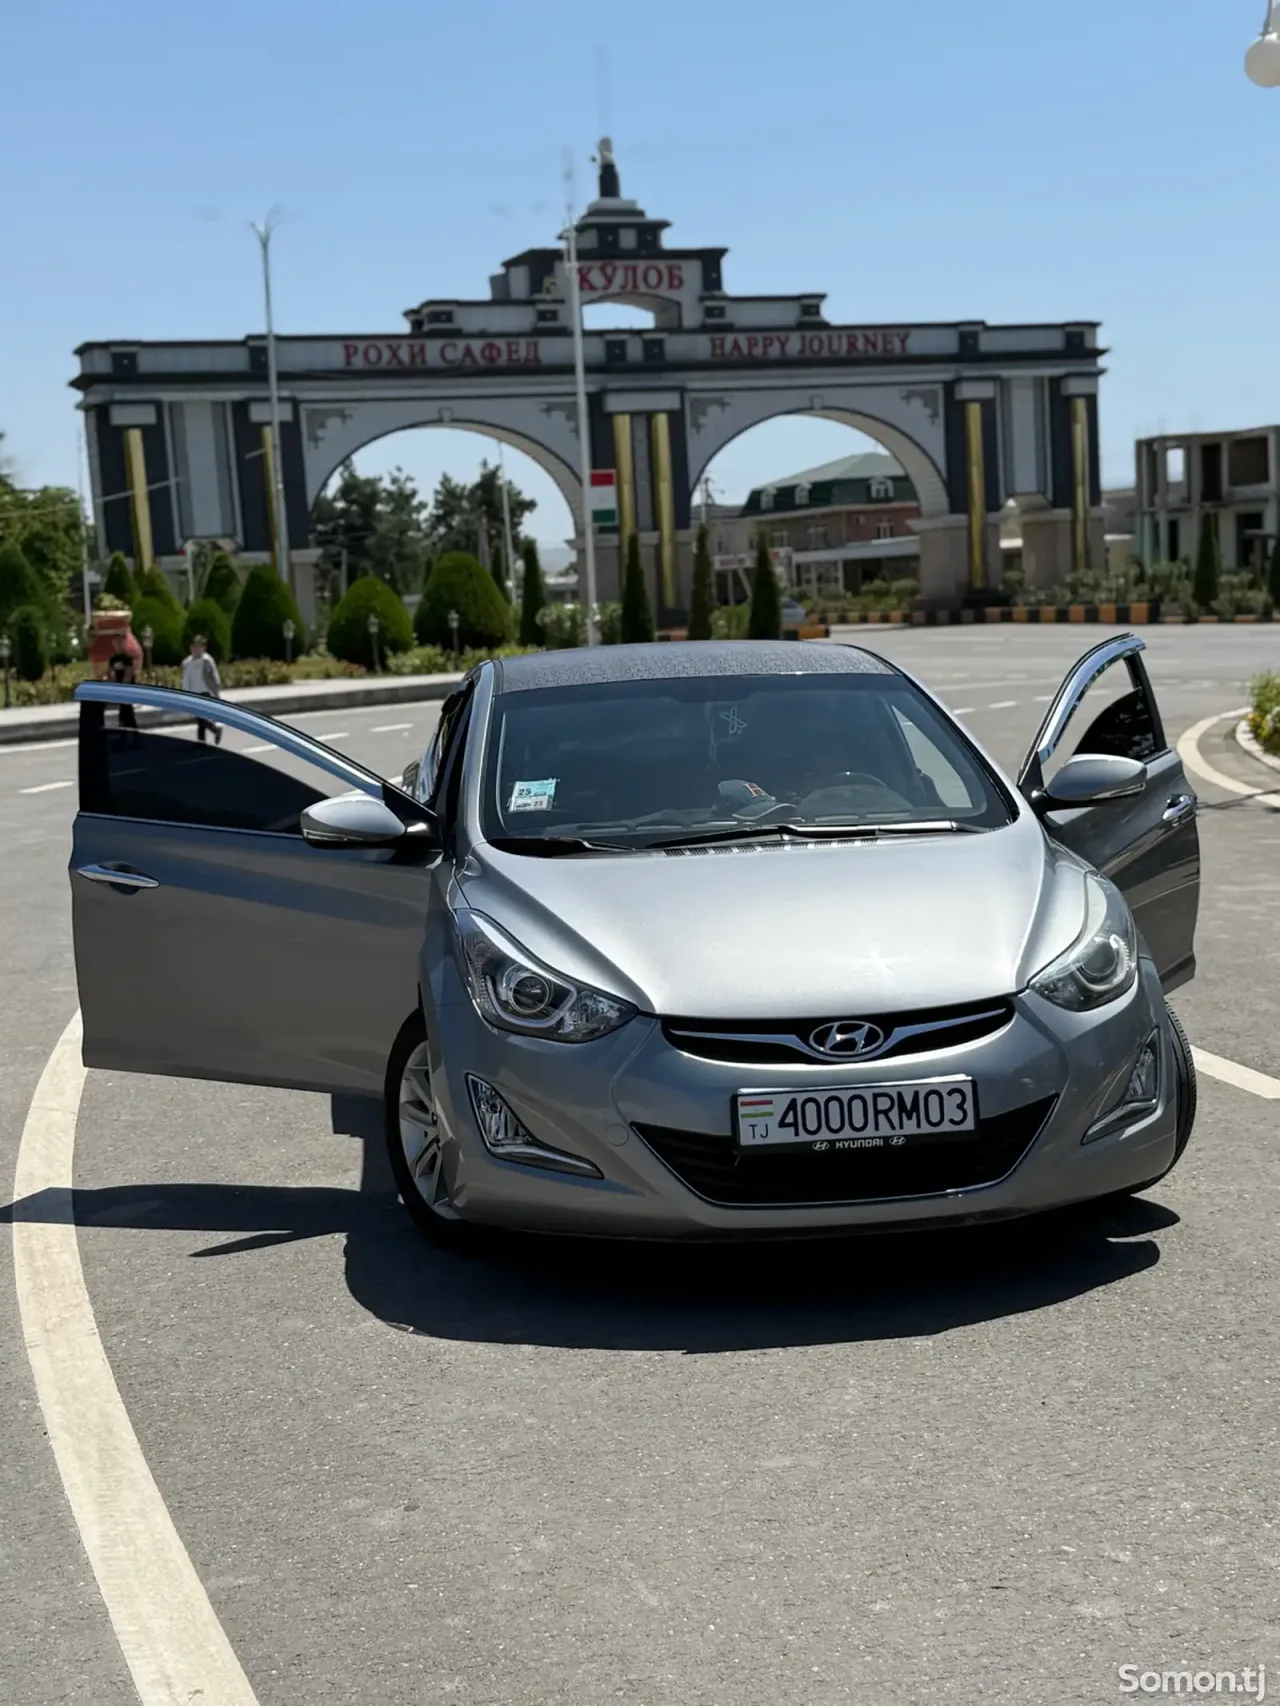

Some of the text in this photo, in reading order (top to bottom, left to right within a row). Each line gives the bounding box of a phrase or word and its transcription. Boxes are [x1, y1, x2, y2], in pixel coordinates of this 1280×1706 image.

[439, 340, 541, 366] САФЕД
[709, 331, 911, 358] HAPPY JOURNEY
[778, 1088, 968, 1137] 4000RM03
[749, 1123, 769, 1139] TJ
[835, 1138, 884, 1149] HYUNDAI
